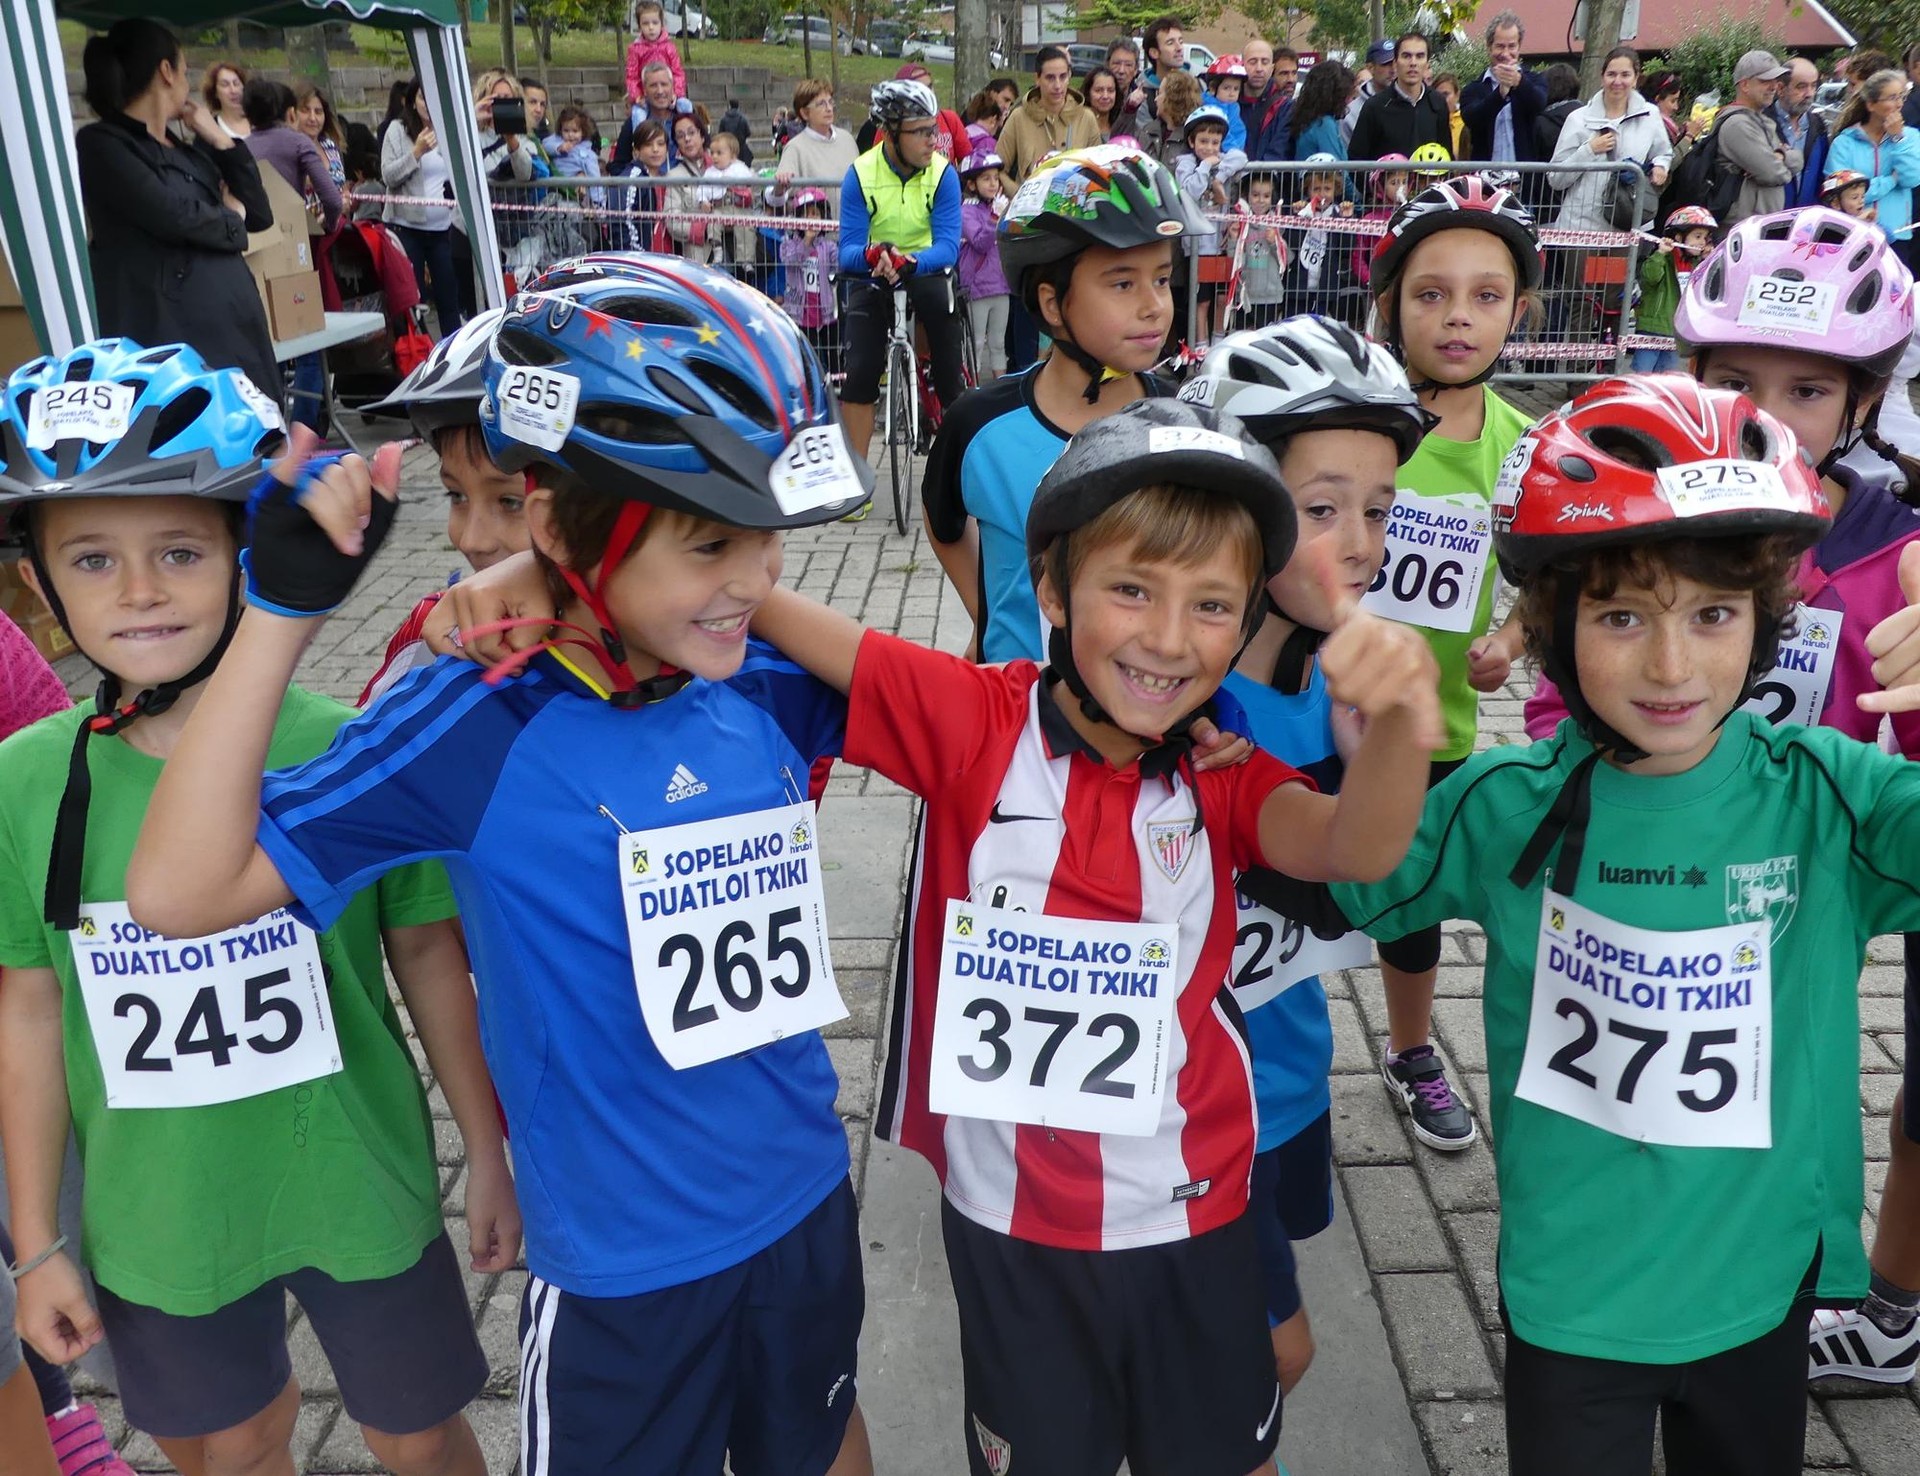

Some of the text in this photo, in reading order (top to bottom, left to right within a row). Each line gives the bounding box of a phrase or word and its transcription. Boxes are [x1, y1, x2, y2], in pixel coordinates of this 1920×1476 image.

[1759, 282, 1816, 305] 252
[46, 386, 113, 411] 245
[508, 371, 562, 410] 265
[789, 434, 834, 469] 265
[1681, 465, 1757, 489] 275
[1557, 503, 1614, 522] Spiuk
[1386, 521, 1480, 554] ATLOI TXIKI
[665, 781, 708, 803] adidas
[664, 832, 784, 879] SOPELAKO
[1598, 861, 1675, 886] luanvi
[639, 858, 808, 921] DUATLOI TXIKI
[90, 944, 215, 977] DUATLOI
[220, 920, 298, 963] TXIKI
[986, 928, 1131, 965] SOPELAKO
[1139, 959, 1170, 968] hirubi
[1575, 929, 1722, 979] SOPELAKO
[657, 905, 811, 1033] 265
[955, 951, 1158, 998] DUATLOI TXIKI
[1549, 944, 1751, 1012] DUATLOI TXIKI
[113, 967, 303, 1072] 245
[957, 997, 1140, 1099] 372
[1547, 998, 1738, 1112] 275
